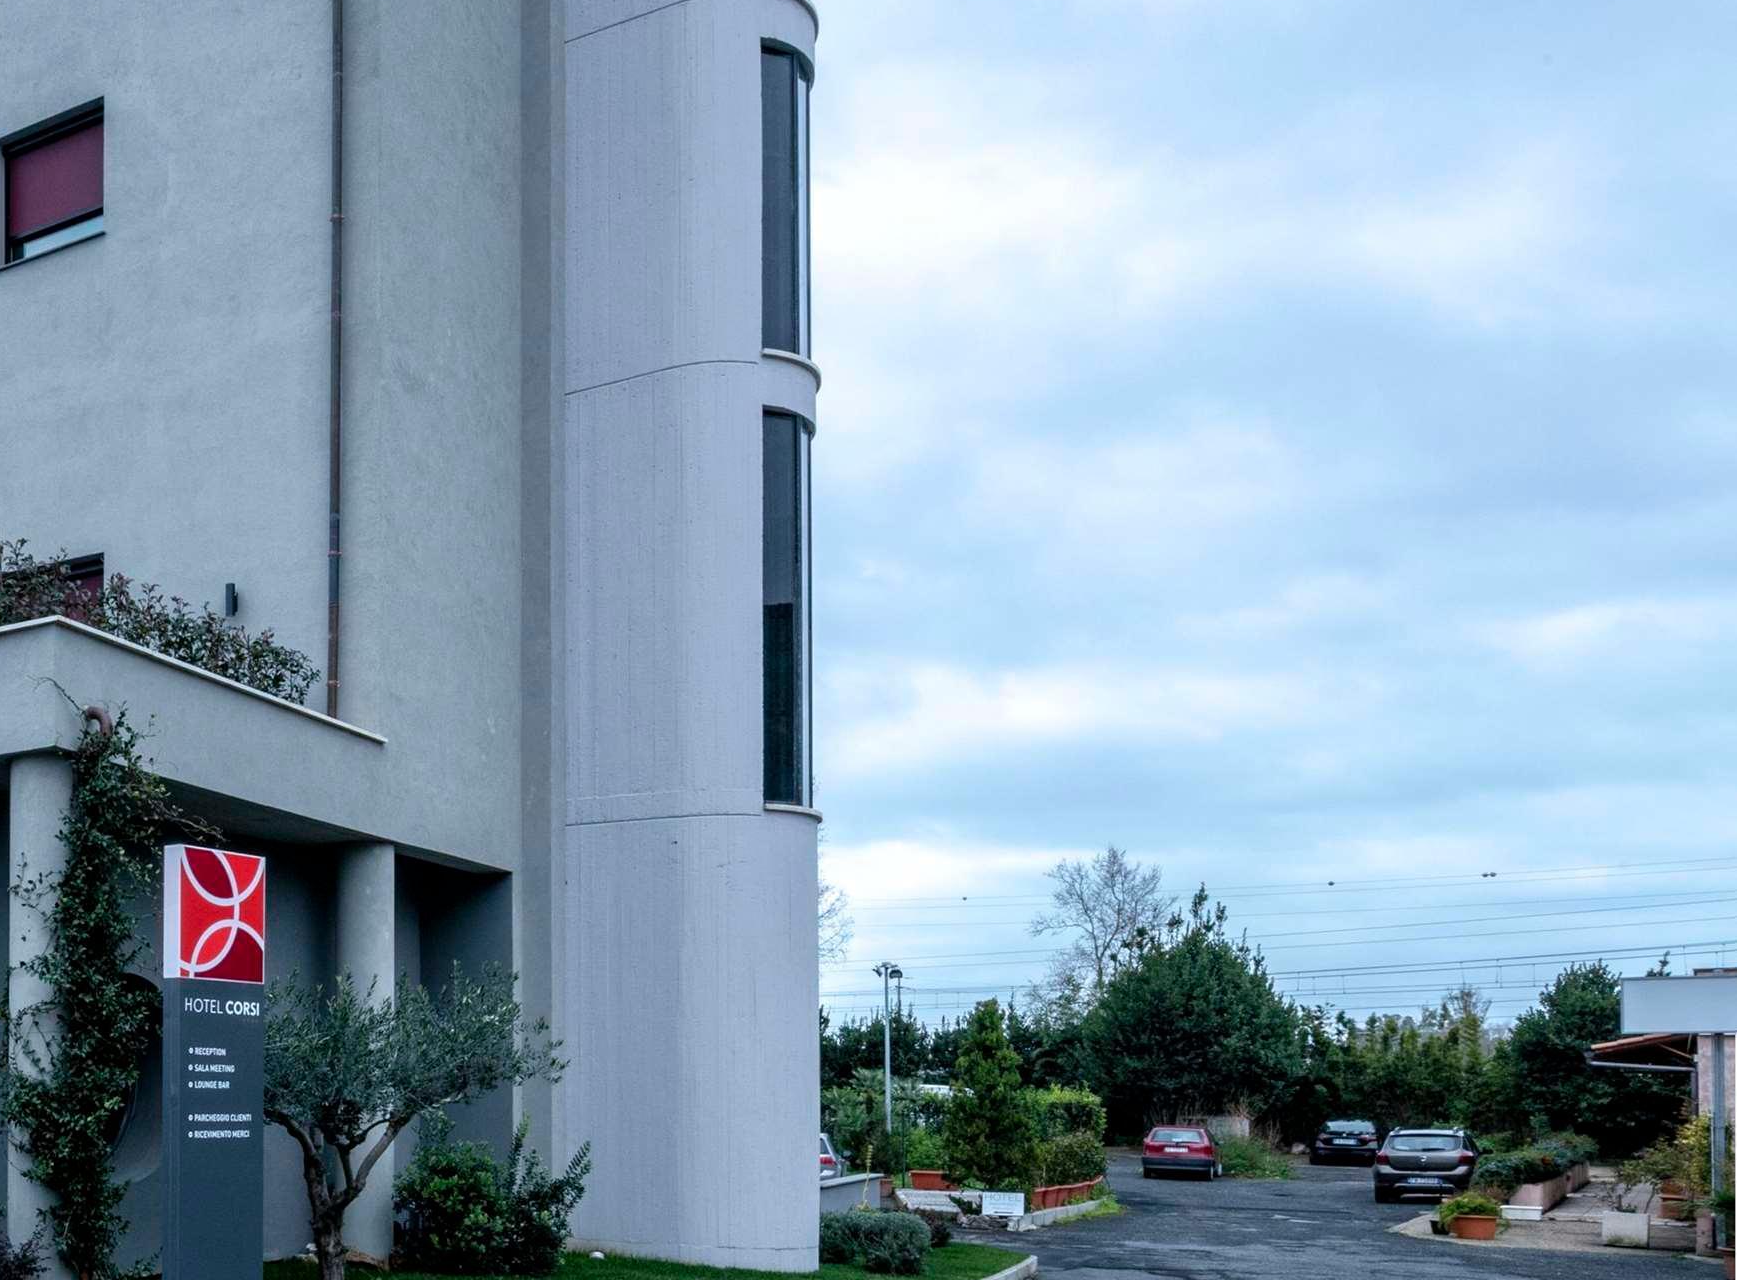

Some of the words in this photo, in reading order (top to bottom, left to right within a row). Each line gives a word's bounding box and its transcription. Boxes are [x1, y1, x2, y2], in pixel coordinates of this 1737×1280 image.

[184, 997, 223, 1015] HOTEL
[225, 1000, 260, 1016] CORSI
[194, 1047, 226, 1056] RECEPTION
[194, 1064, 209, 1072] SALA
[210, 1064, 235, 1073] MEETING
[194, 1080, 217, 1089] LOUNGE
[218, 1081, 230, 1089] BAR
[194, 1113, 230, 1122] PARCHEGGIO
[230, 1113, 252, 1122] CLIENTI
[194, 1130, 232, 1139] RICEVIMENTO
[232, 1130, 250, 1138] MERCI
